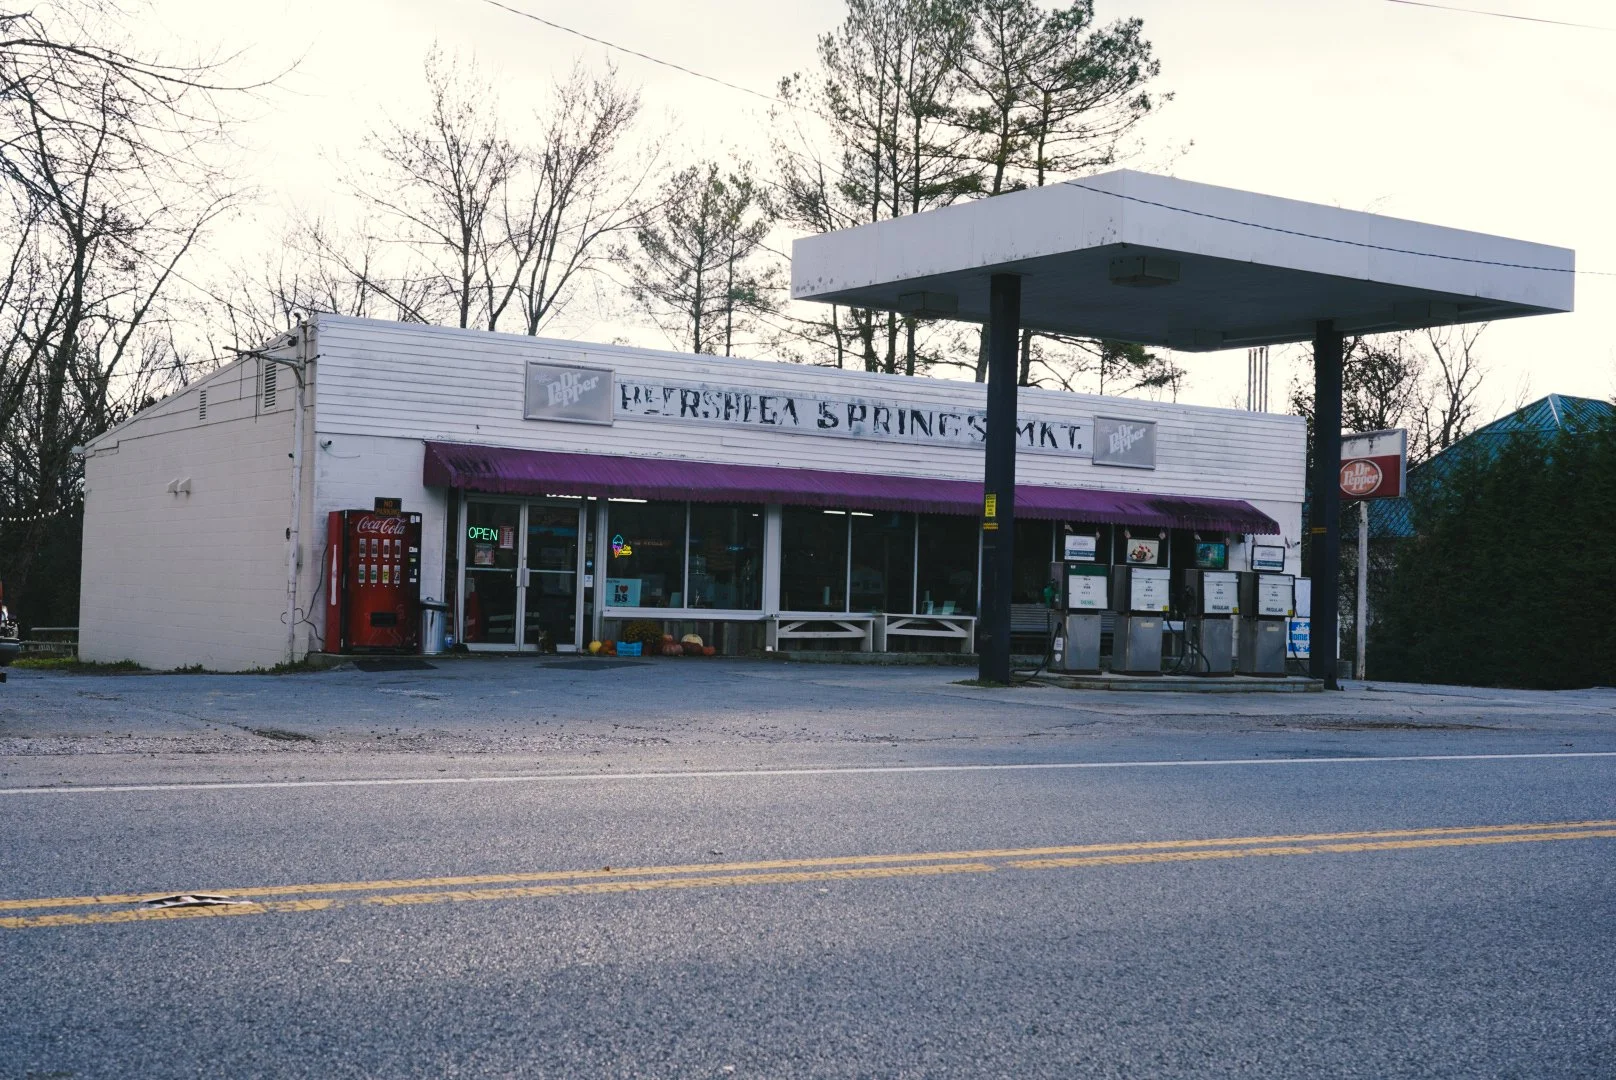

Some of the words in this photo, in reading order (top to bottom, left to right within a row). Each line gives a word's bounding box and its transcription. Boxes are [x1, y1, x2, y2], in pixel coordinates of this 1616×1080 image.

[560, 371, 582, 388] Dr
[547, 375, 600, 408] Pepper
[817, 401, 987, 442] SPRINGS
[1119, 423, 1133, 438] Dr
[1109, 426, 1146, 454] Pepper
[1354, 462, 1370, 476] Dr
[1343, 470, 1378, 490] Pepper
[357, 515, 407, 535] Coca-Cola
[468, 526, 498, 541] OPEN
